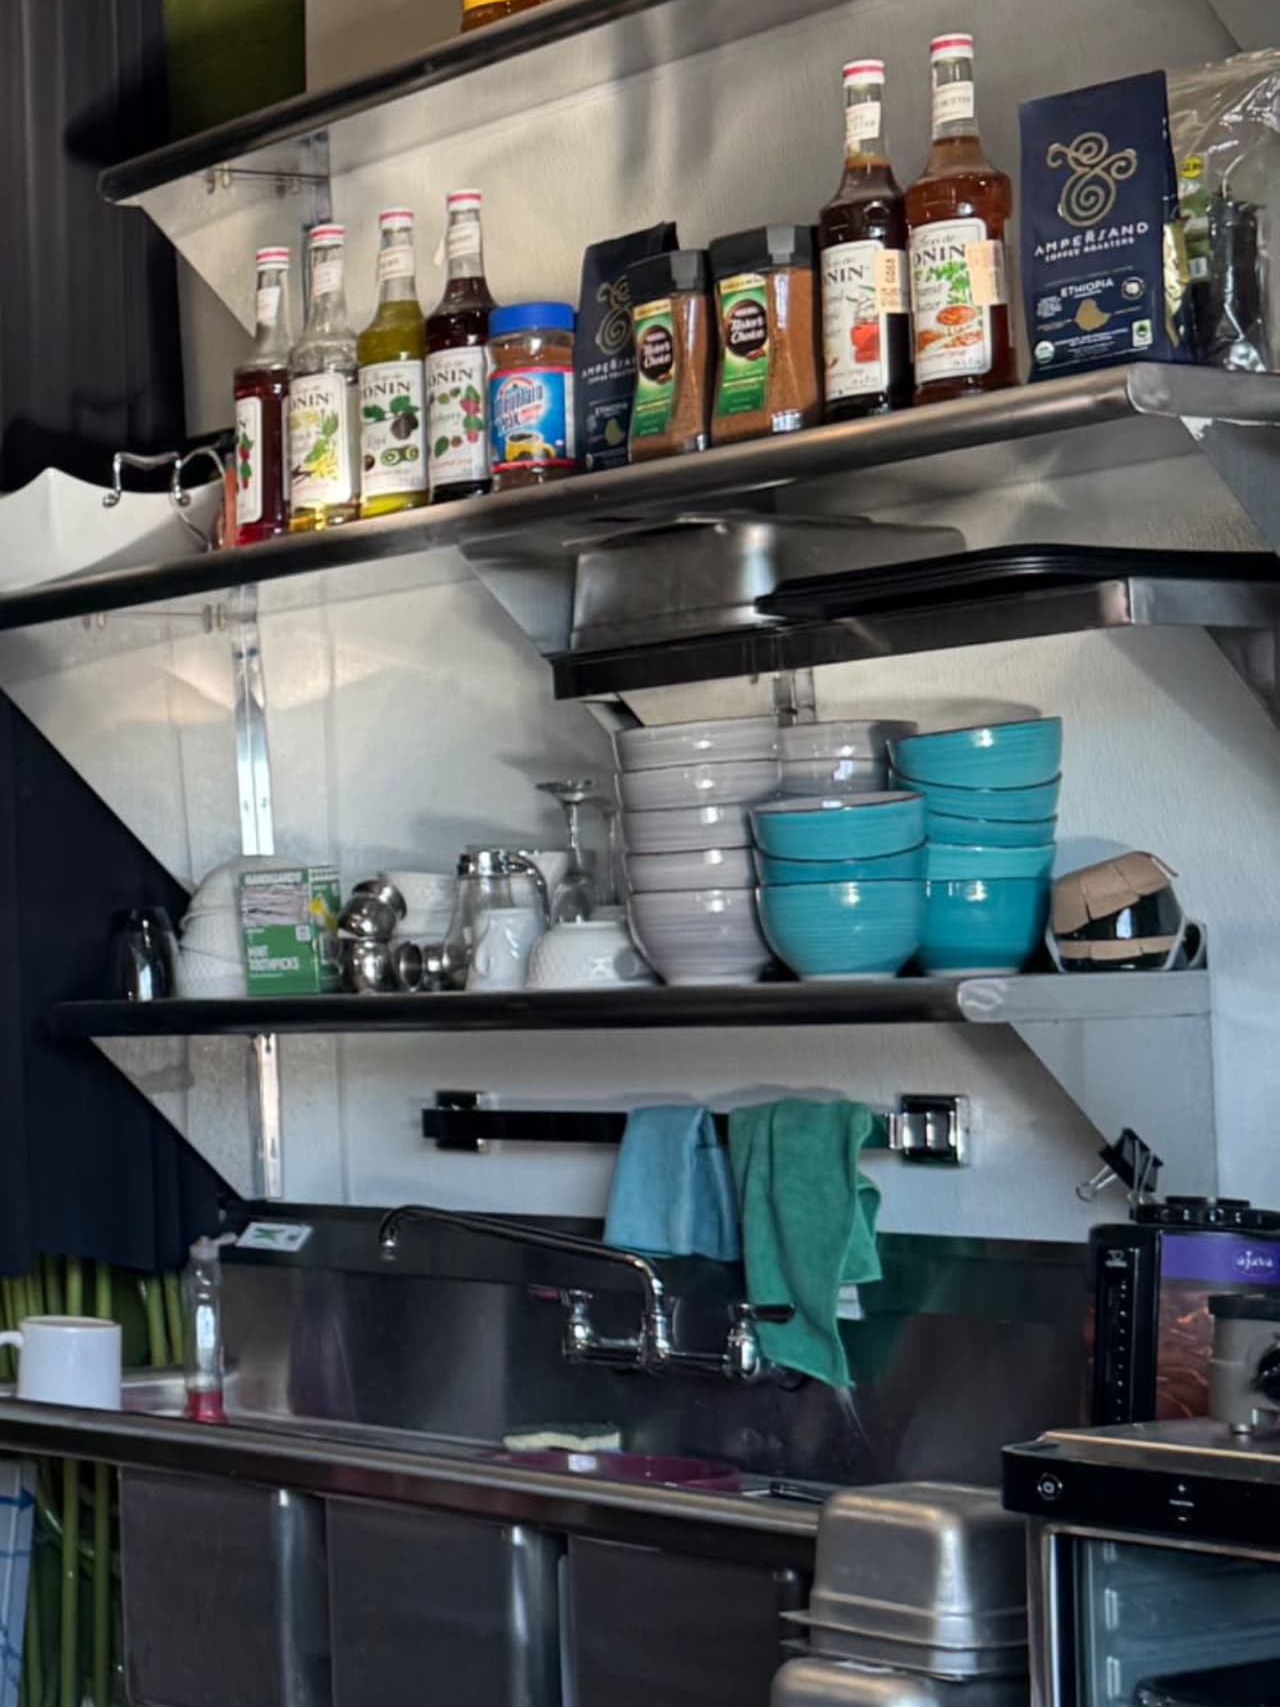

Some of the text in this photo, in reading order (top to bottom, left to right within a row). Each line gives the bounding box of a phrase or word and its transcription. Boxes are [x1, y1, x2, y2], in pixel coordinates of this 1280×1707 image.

[1035, 221, 1150, 257] AMPERSAND
[913, 246, 966, 266] ONIN
[1061, 277, 1115, 298] ETHIOPIA
[427, 368, 473, 388] ONIN
[363, 381, 411, 399] ONIN
